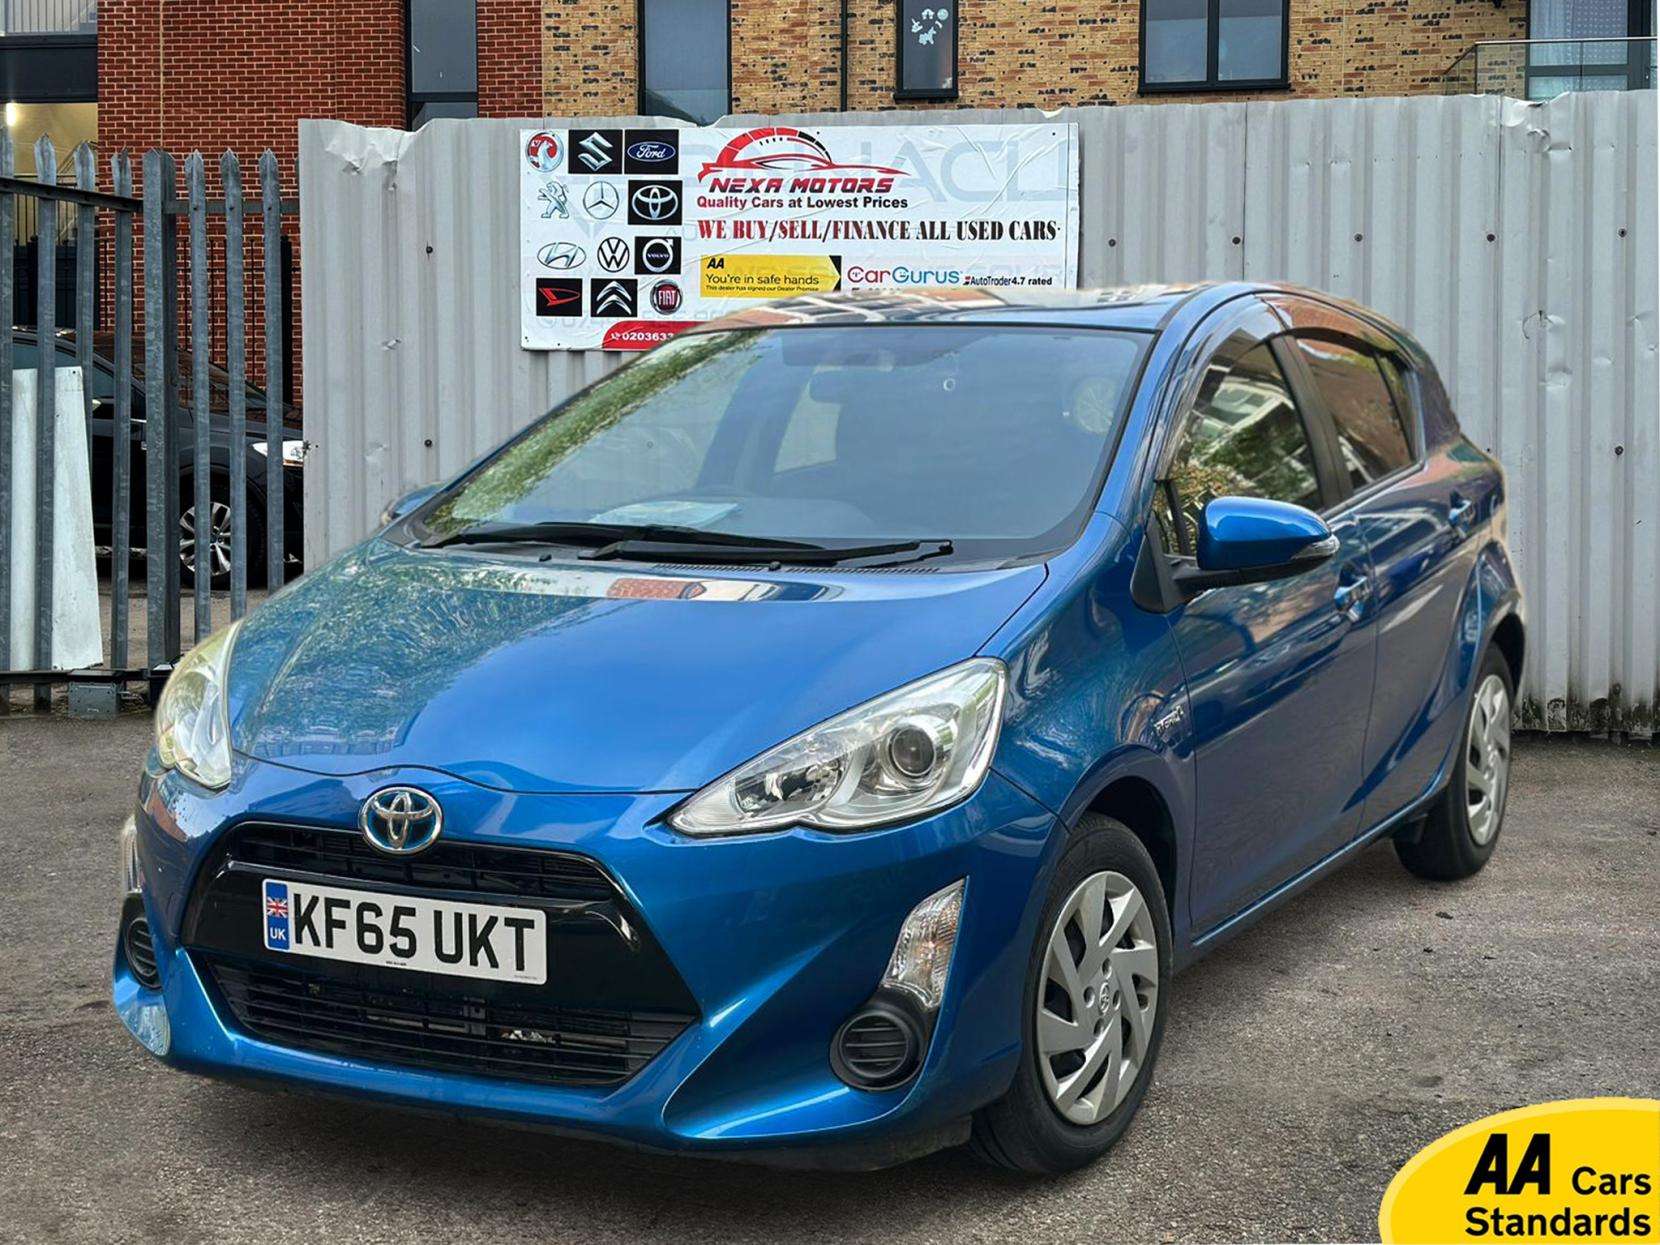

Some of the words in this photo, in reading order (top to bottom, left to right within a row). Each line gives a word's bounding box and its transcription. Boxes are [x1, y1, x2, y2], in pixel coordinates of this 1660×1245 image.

[636, 145, 665, 159] Ford
[709, 178, 784, 194] NEXA
[789, 178, 894, 194] MOTORS
[697, 195, 748, 210] Quality
[751, 196, 784, 208] Cars
[788, 197, 803, 208] at
[807, 196, 859, 208] Lowest
[863, 197, 908, 209] Prices
[698, 220, 726, 239] WE
[916, 221, 950, 240] ALL
[956, 220, 1003, 240] USED
[707, 258, 725, 269] AA
[706, 274, 741, 284] You're
[744, 274, 754, 284] in
[757, 274, 781, 284] safe
[784, 275, 820, 285] hands
[847, 266, 960, 284] CarGurus
[1028, 277, 1053, 286] rated
[658, 290, 676, 306] FIAT
[270, 928, 287, 941] UK
[293, 894, 417, 959] KF65
[434, 910, 536, 971] UKT
